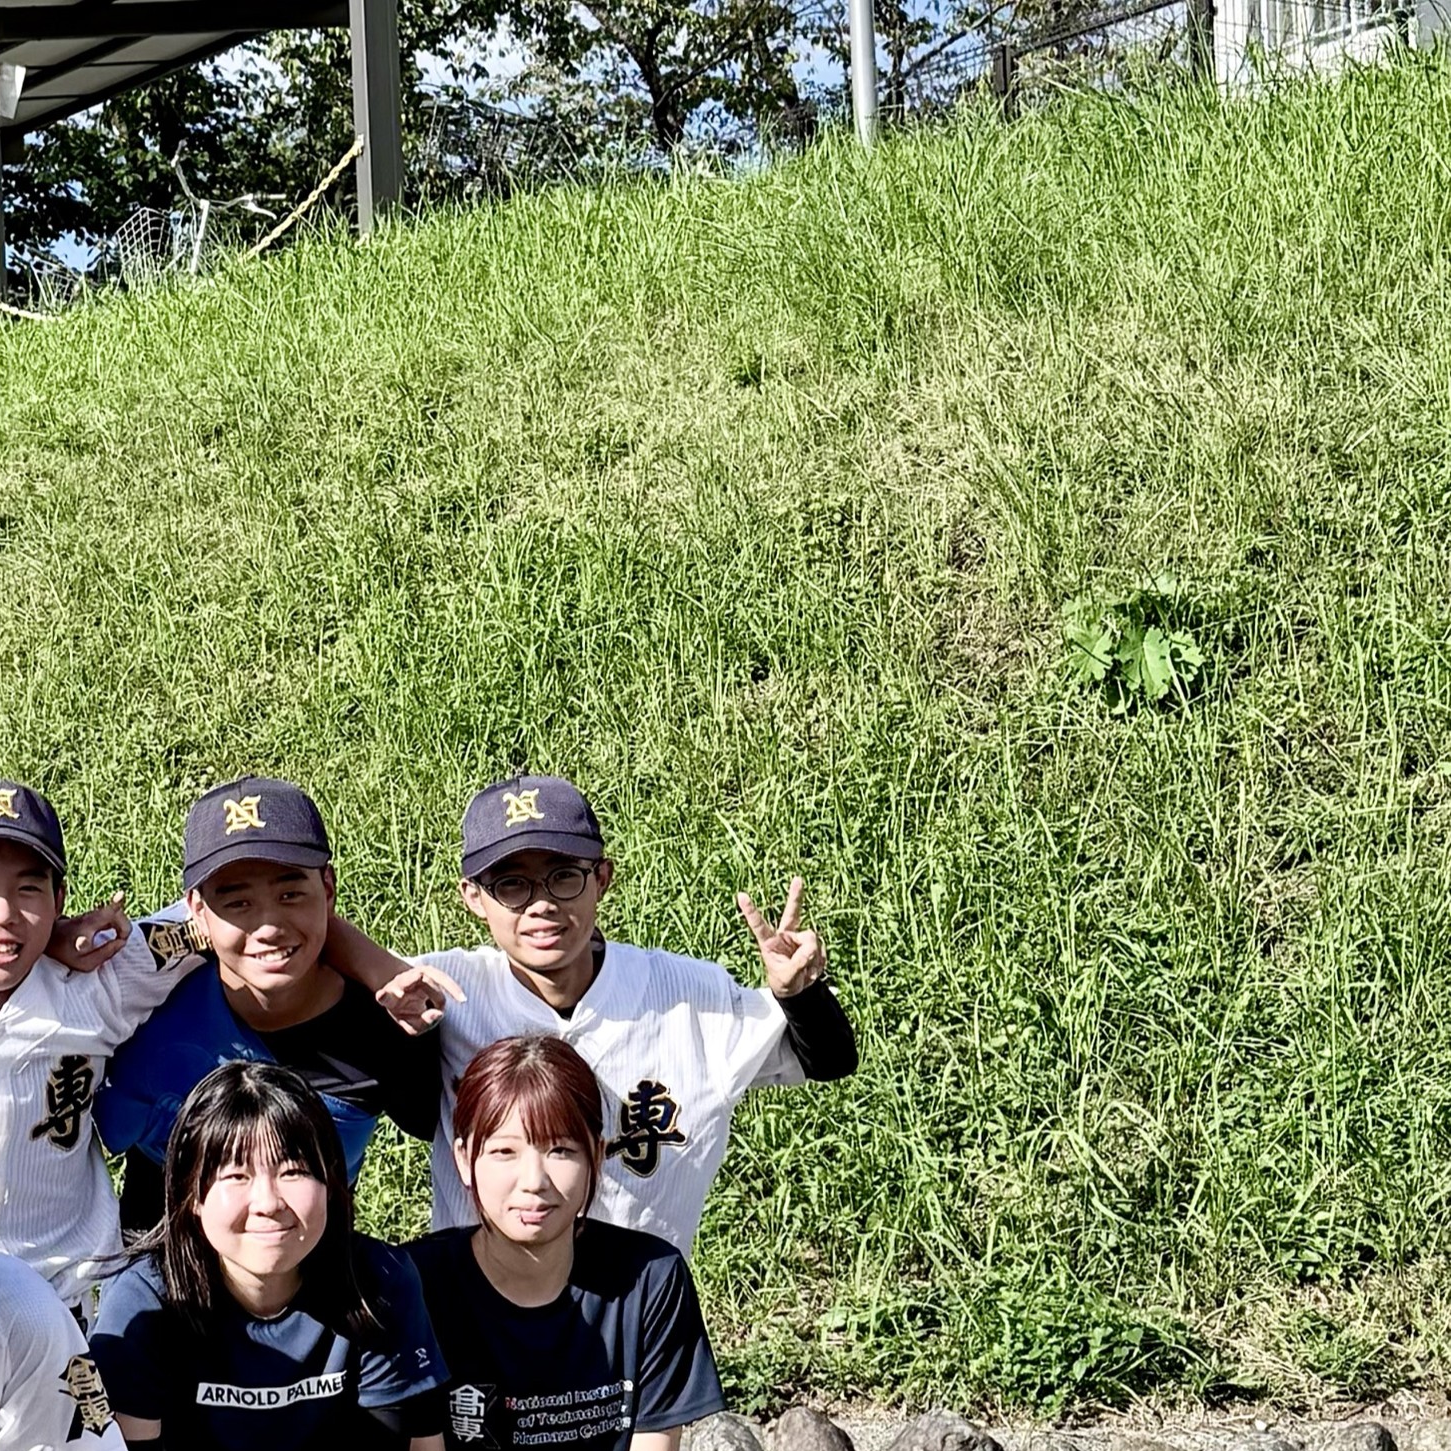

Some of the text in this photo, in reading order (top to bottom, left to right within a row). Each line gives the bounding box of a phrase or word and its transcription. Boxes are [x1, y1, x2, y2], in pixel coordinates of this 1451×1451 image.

[223, 794, 267, 836] N
[502, 788, 545, 828] N
[201, 1376, 343, 1406] ARNOLD PALME
